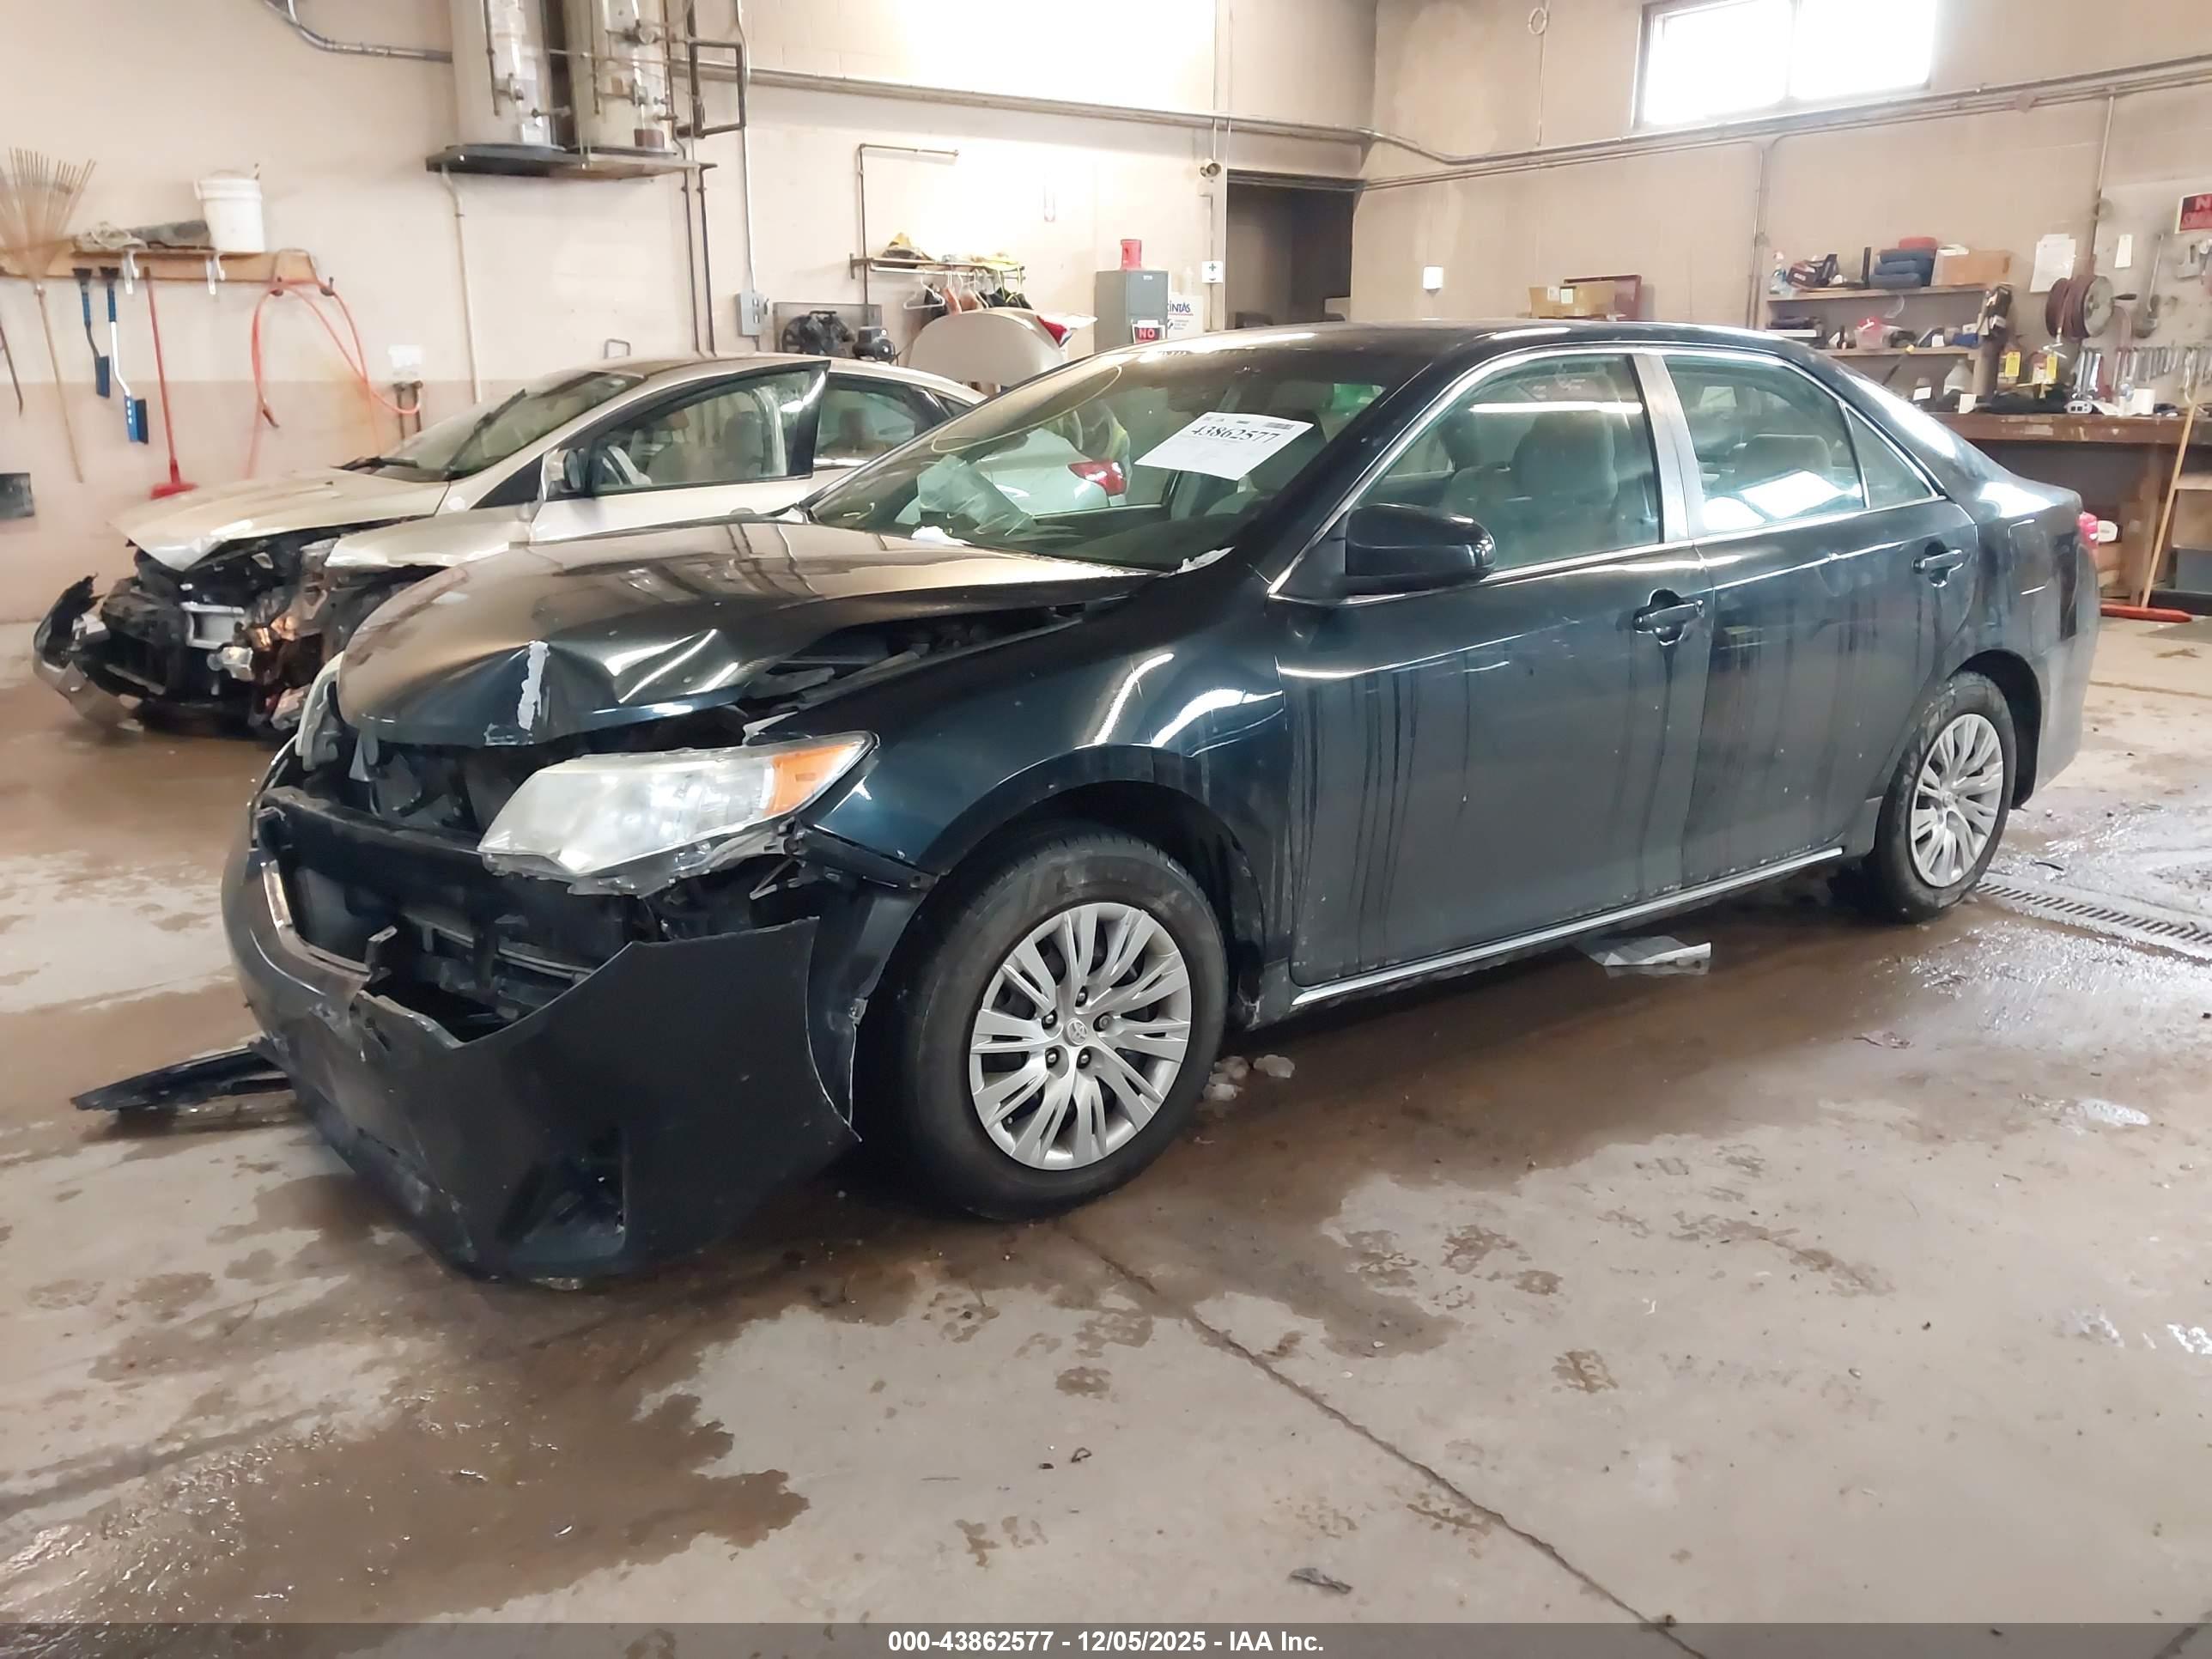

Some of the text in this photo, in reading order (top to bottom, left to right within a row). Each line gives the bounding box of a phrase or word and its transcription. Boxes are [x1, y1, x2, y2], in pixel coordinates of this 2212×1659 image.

[2195, 196, 2212, 210] N
[1168, 301, 1190, 313] INTAS
[1139, 328, 1155, 339] NO
[1192, 425, 1280, 443] 43862577
